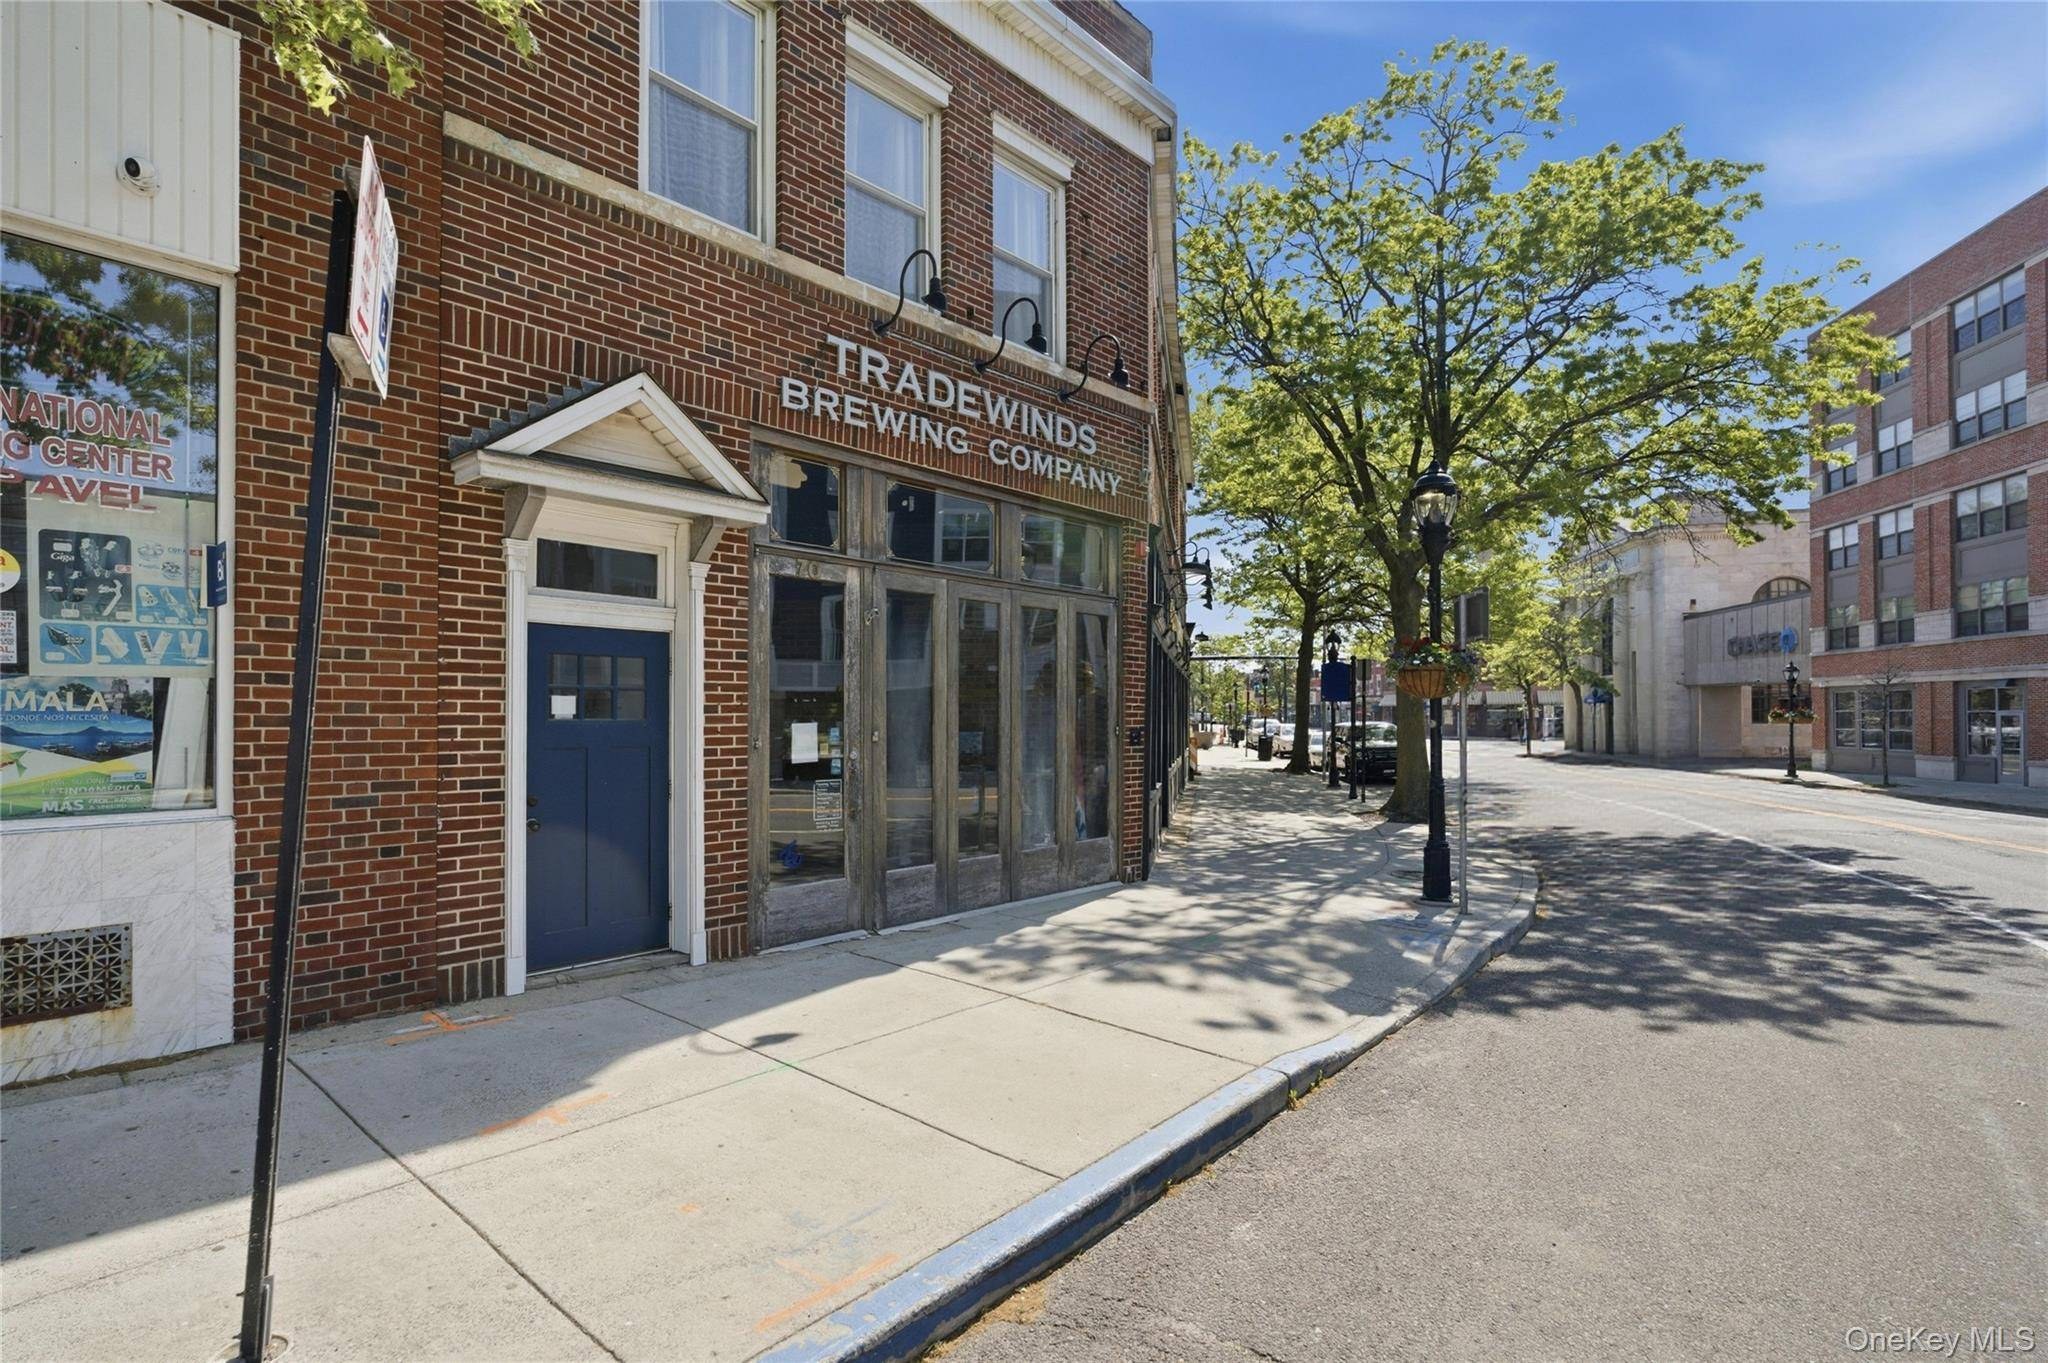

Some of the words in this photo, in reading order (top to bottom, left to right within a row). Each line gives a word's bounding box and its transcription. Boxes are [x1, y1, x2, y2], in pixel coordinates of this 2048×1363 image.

[825, 334, 1098, 456] TRADEWINDS
[40, 436, 176, 483] CENTER
[780, 376, 970, 455] BREWING
[988, 438, 1123, 496] COMPANY
[5, 690, 109, 712] MALA
[42, 797, 84, 812] MÁS
